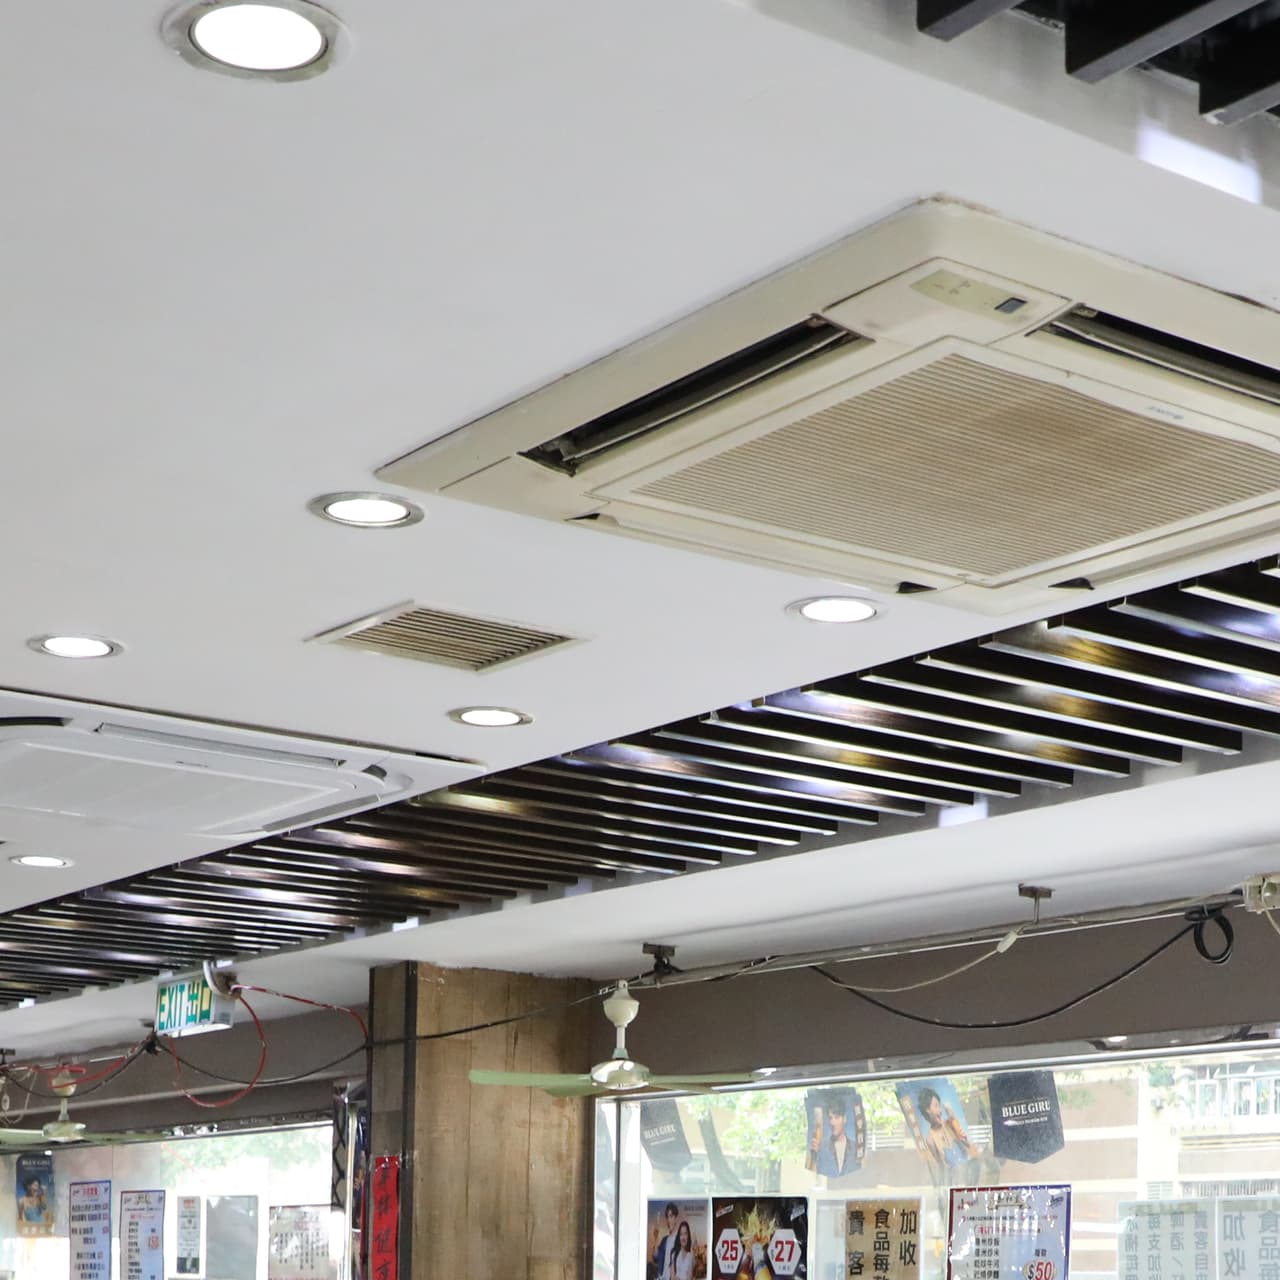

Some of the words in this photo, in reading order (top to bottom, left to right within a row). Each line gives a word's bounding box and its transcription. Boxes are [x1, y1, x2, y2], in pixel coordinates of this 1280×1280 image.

[159, 984, 185, 1030] EXIT
[186, 979, 212, 1023] 出口
[1002, 1104, 1027, 1117] BLUE
[1028, 1101, 1050, 1113] GIRL
[1028, 1262, 1052, 1280] $50
